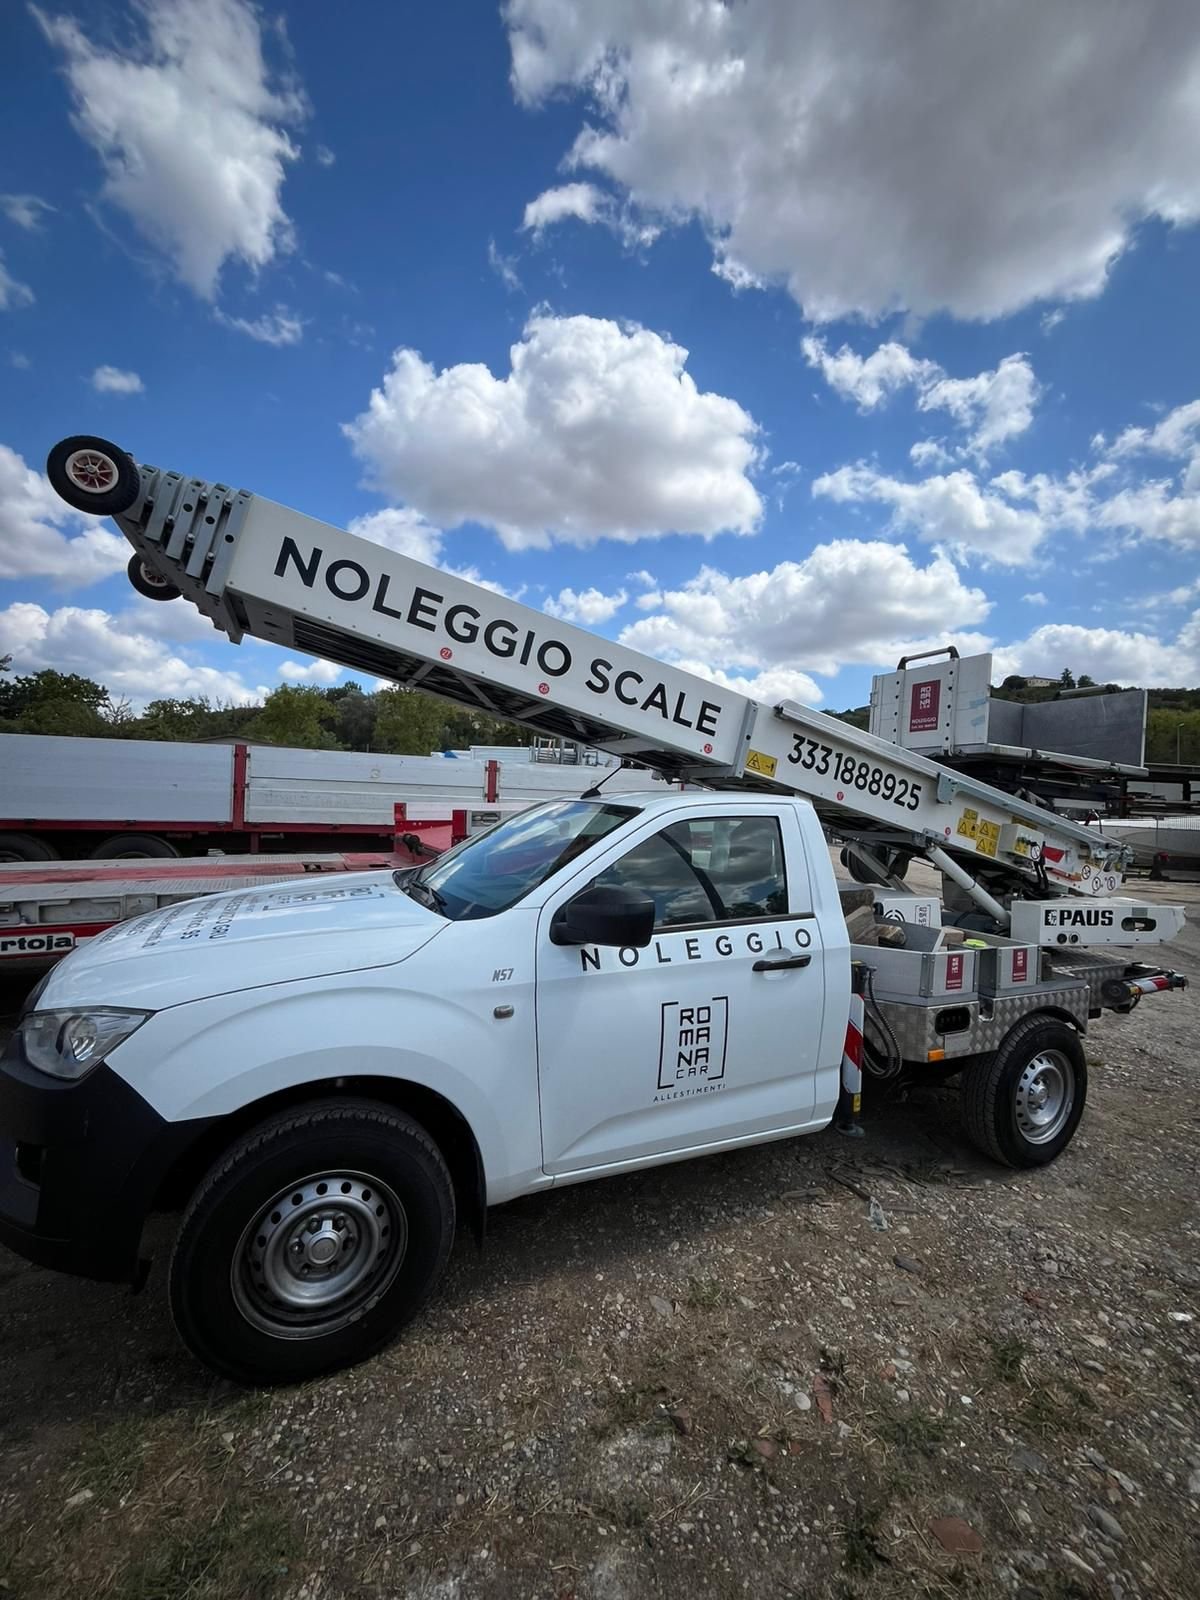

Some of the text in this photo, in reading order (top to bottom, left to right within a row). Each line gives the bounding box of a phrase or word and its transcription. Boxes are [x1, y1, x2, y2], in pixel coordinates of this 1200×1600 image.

[274, 536, 722, 737] NOLEGGIO SCALE
[787, 733, 922, 811] 3331888925
[1059, 909, 1114, 926] PAUS
[0, 935, 73, 952] rtoja
[580, 928, 812, 972] NOLEGGIO
[676, 1065, 708, 1080] CAR
[653, 1083, 726, 1103] ALLESTIMENTI
